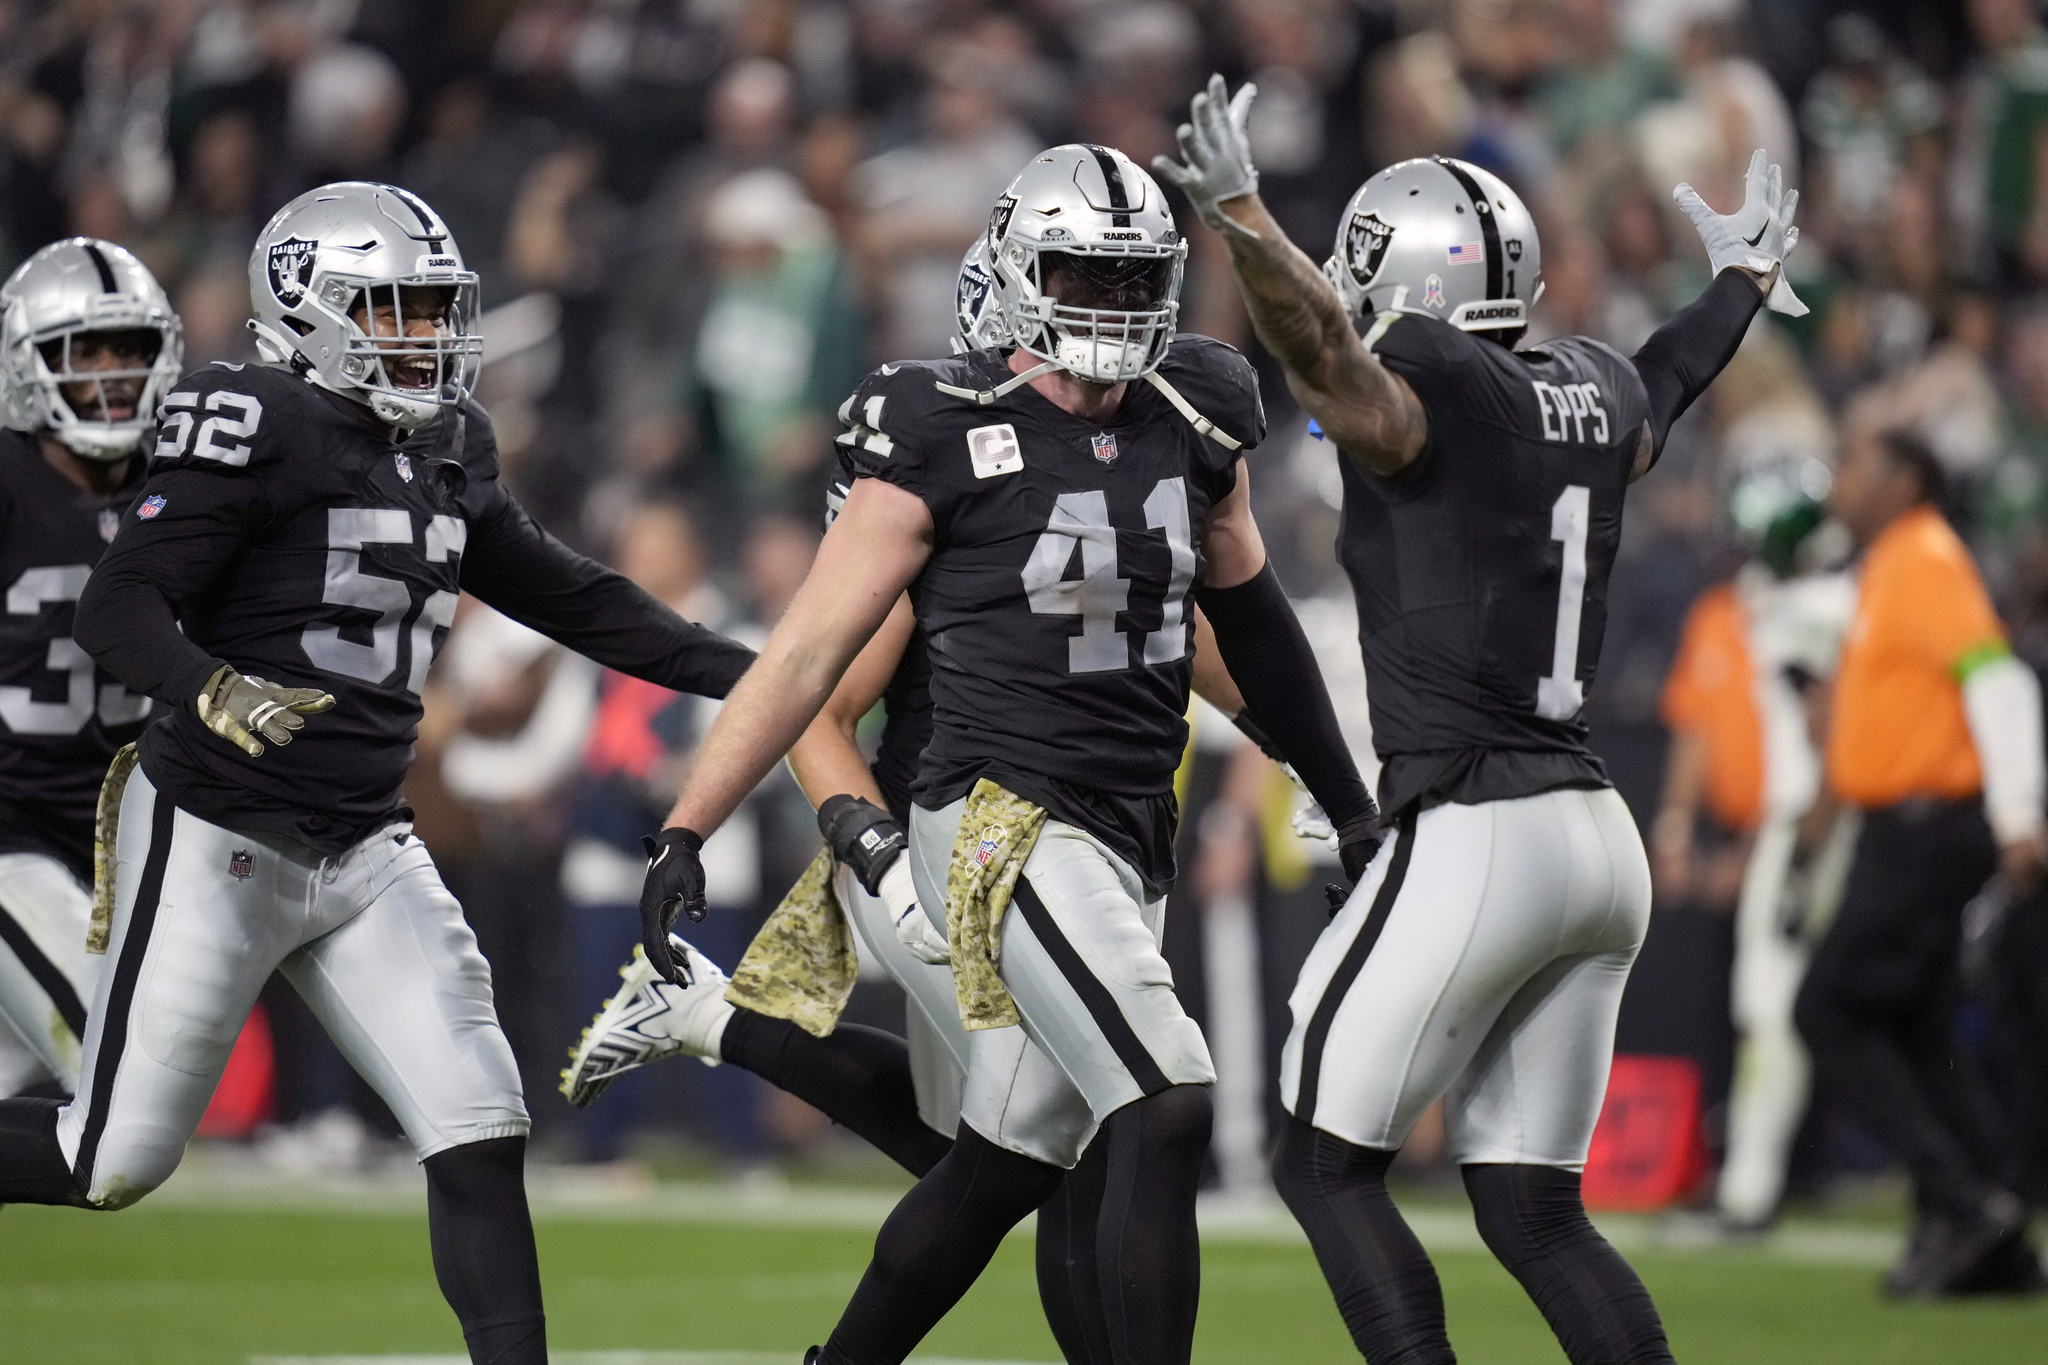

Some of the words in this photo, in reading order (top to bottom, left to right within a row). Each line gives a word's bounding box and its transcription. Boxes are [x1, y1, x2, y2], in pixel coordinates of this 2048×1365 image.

[1352, 214, 1391, 236] RAIDERS
[1103, 232, 1143, 241] RAIDERS
[271, 242, 314, 256] RAIDERS
[428, 258, 457, 267] RAIDERS
[1505, 270, 1516, 299] 1
[1465, 307, 1520, 321] RAIDERS
[1532, 380, 1610, 444] EPPS
[154, 390, 263, 467] 52
[1097, 445, 1116, 458] NFL
[139, 503, 158, 517] NFL
[1020, 476, 1197, 674] 41
[1534, 484, 1591, 721] 1
[977, 849, 992, 865] NF
[232, 861, 250, 875] NFL
